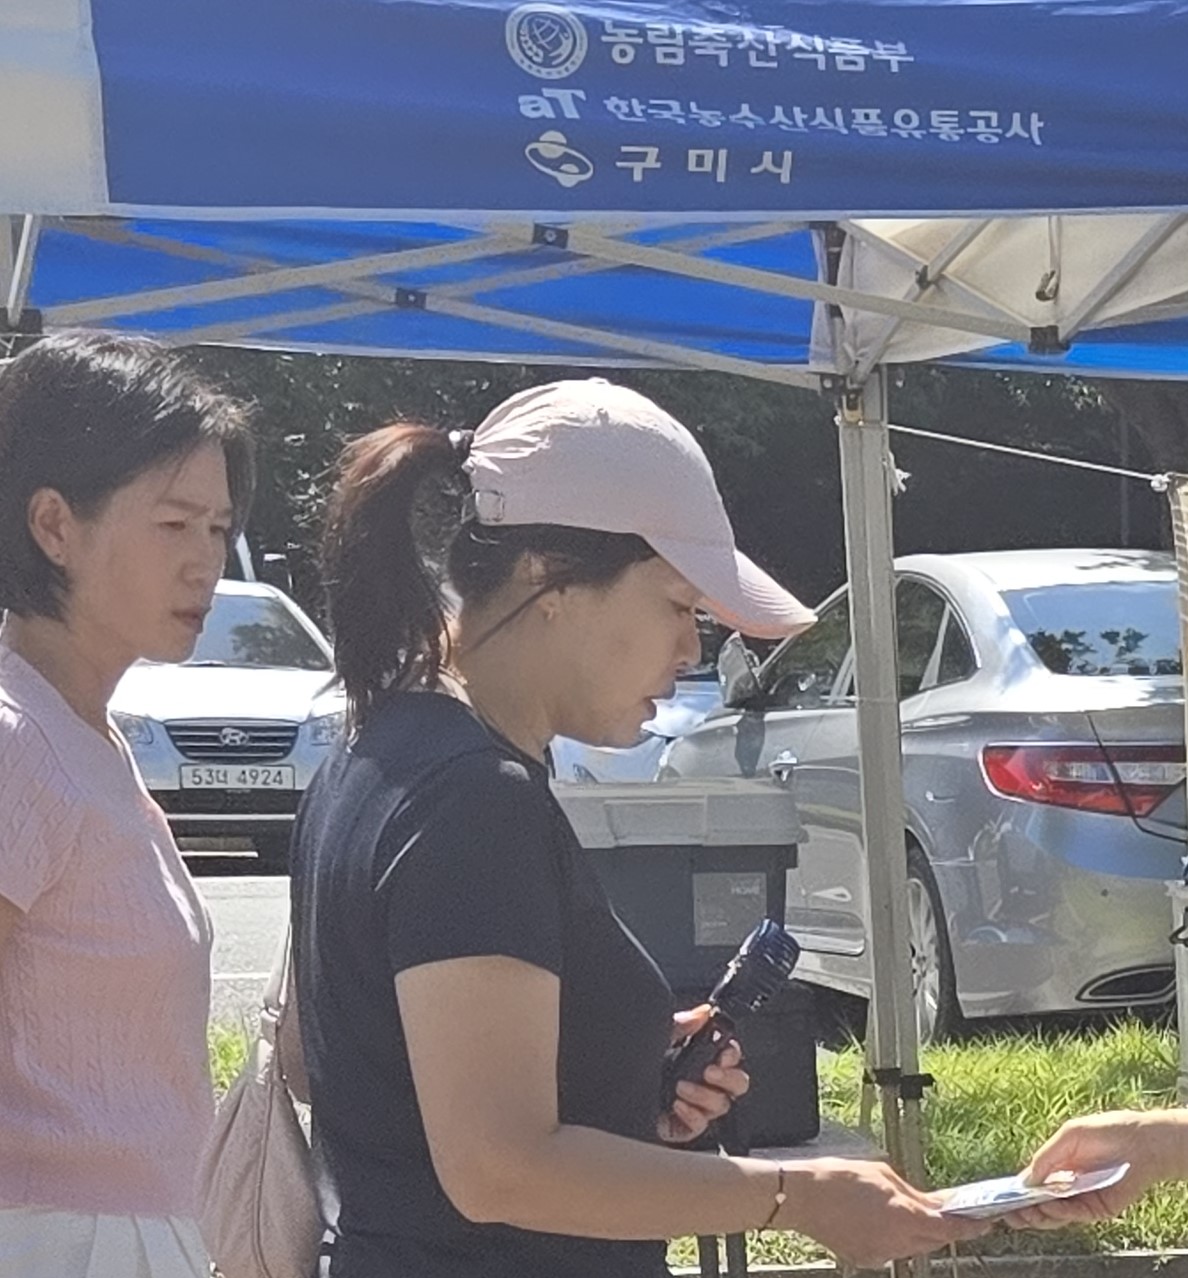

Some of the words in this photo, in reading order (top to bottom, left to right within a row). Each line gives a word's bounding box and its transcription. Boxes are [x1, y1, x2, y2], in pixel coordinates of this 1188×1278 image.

[601, 21, 915, 73] 농림축산식품부
[518, 88, 586, 119] aT
[238, 769, 284, 786] 4924
